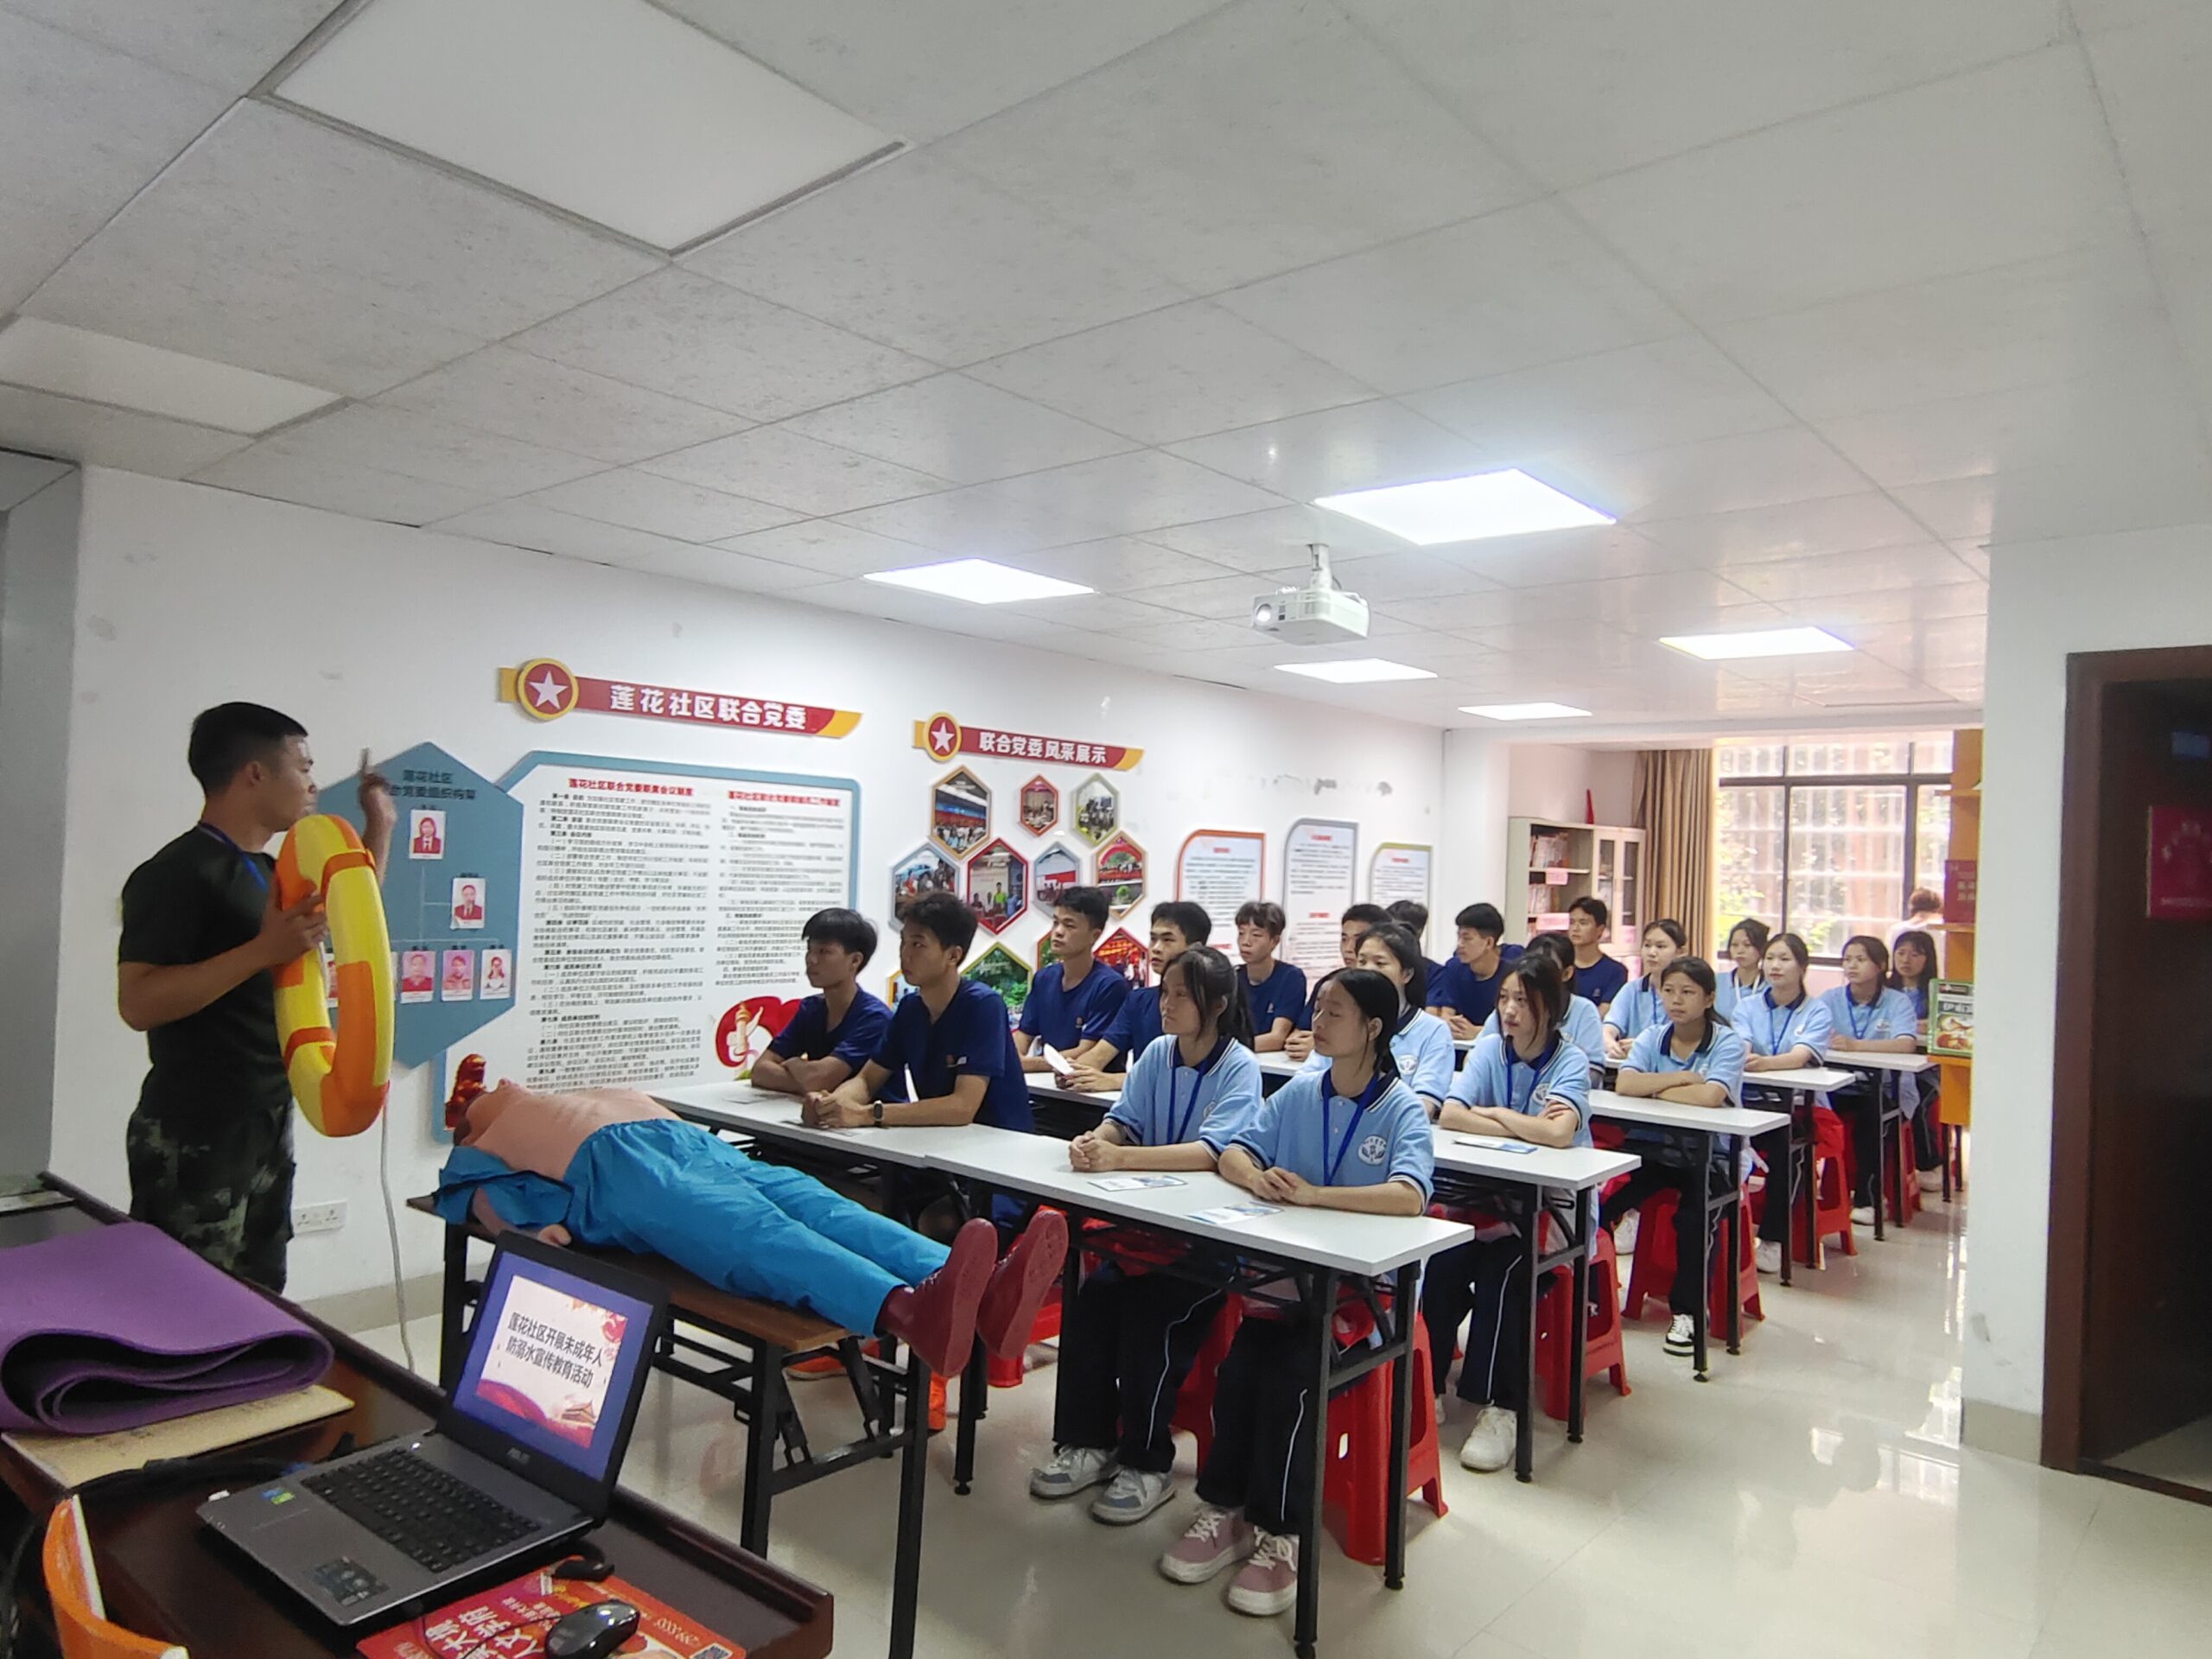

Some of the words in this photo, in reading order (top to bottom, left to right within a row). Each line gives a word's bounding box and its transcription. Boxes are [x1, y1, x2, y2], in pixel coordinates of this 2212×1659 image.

[610, 684, 807, 731] 莲花社区联合党委
[979, 731, 1107, 765] 联合党委风采展示
[388, 785, 477, 800] 合党委组织构架
[508, 1312, 603, 1368] 莲花社区开展未成年人
[505, 1336, 594, 1389] 防溺水宣传教育活动
[425, 1619, 508, 1659] 美大埔
